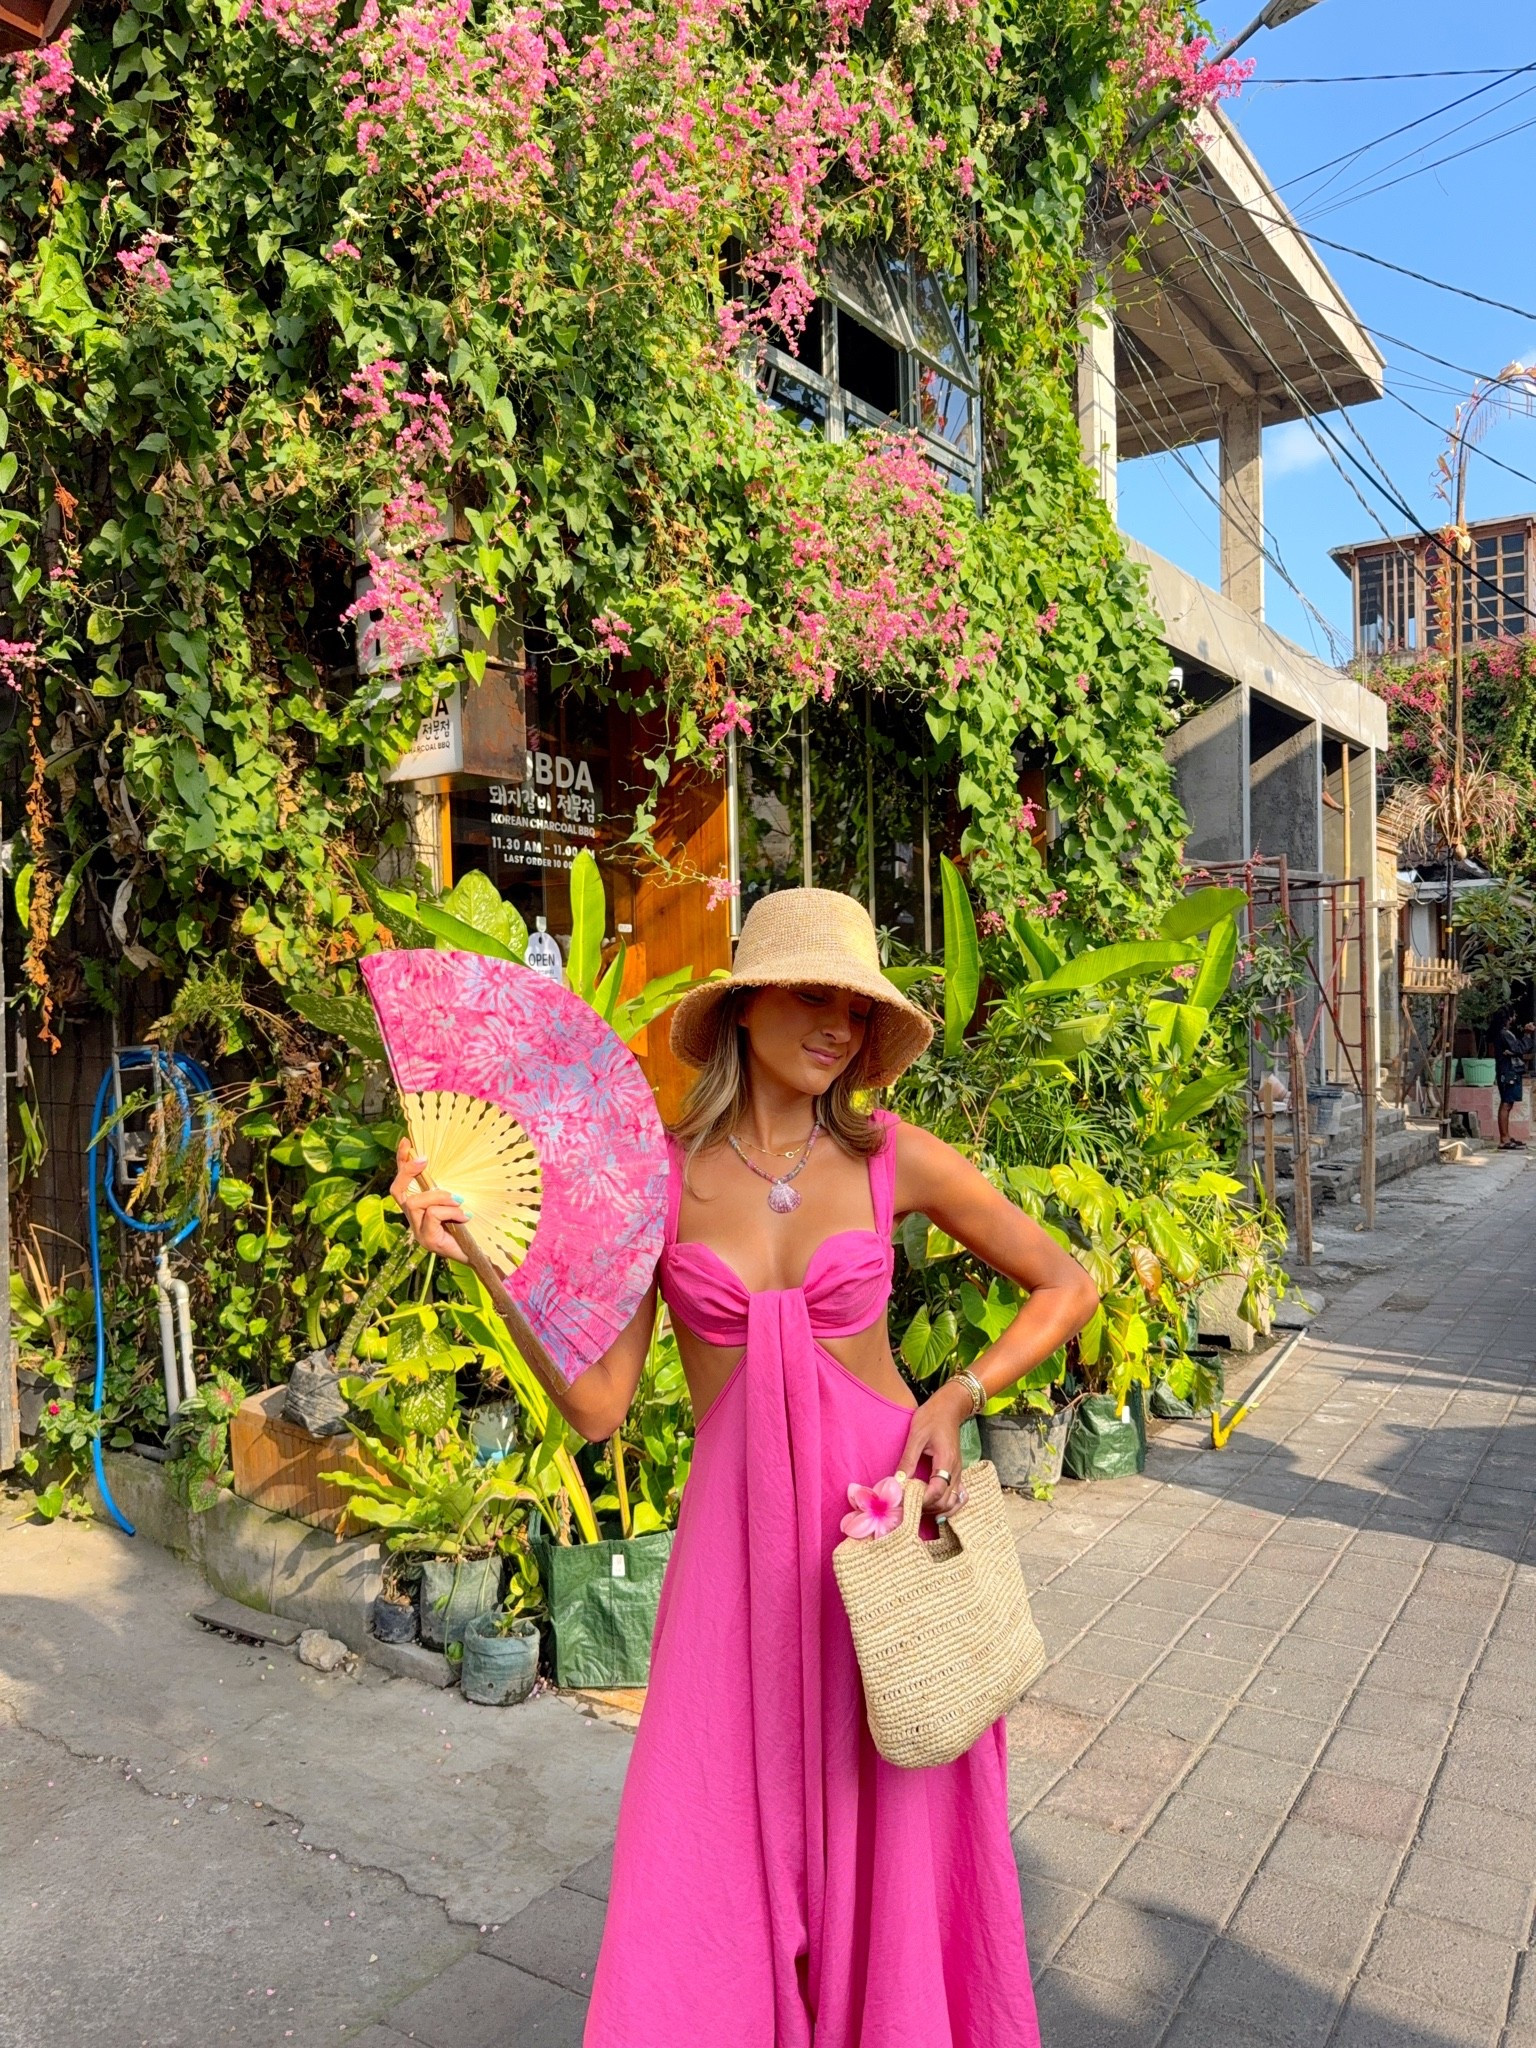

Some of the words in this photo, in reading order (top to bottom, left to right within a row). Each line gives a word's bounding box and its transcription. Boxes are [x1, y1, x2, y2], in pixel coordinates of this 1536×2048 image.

[422, 719, 450, 740] 전문점
[437, 741, 450, 749] BBQ
[488, 784, 552, 814] 돼지갈비
[556, 793, 596, 823] 전문점
[491, 813, 529, 828] KOREAN
[530, 819, 578, 835] CHARCOAL
[577, 826, 596, 839] BBQ
[492, 837, 521, 851] 11.30
[524, 841, 542, 854] AM
[554, 844, 579, 857] 11.00
[504, 854, 525, 864] LAST
[526, 857, 552, 868] ORDER
[528, 953, 555, 967] OPEN
